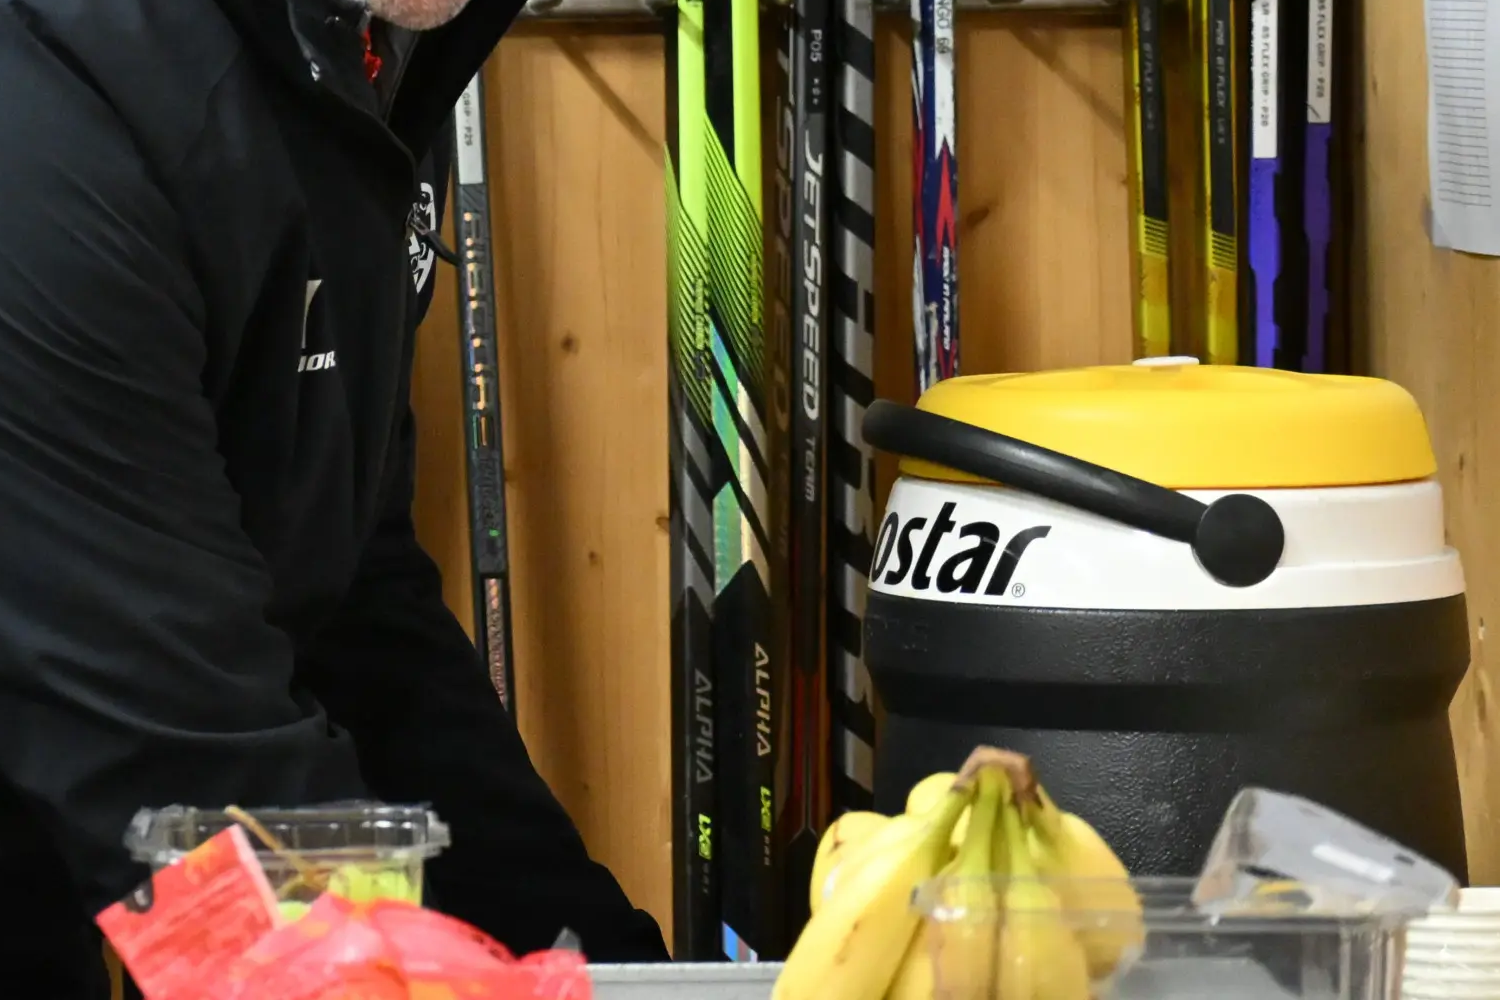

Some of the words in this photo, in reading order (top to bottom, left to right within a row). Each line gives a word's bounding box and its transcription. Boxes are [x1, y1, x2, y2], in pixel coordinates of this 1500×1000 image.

[1316, 13, 1326, 39] FLEX
[808, 29, 822, 62] P05
[1261, 42, 1270, 68] FLEX
[1316, 42, 1326, 68] GRIP
[1216, 75, 1226, 107] FLEX
[1261, 71, 1270, 96] GRIP
[462, 92, 472, 117] GRIP
[801, 130, 823, 421] JETSPEED
[804, 435, 817, 501] TEAM
[871, 502, 1052, 597] ostar
[755, 642, 771, 757] ALPHA
[695, 668, 713, 784] ALPHA
